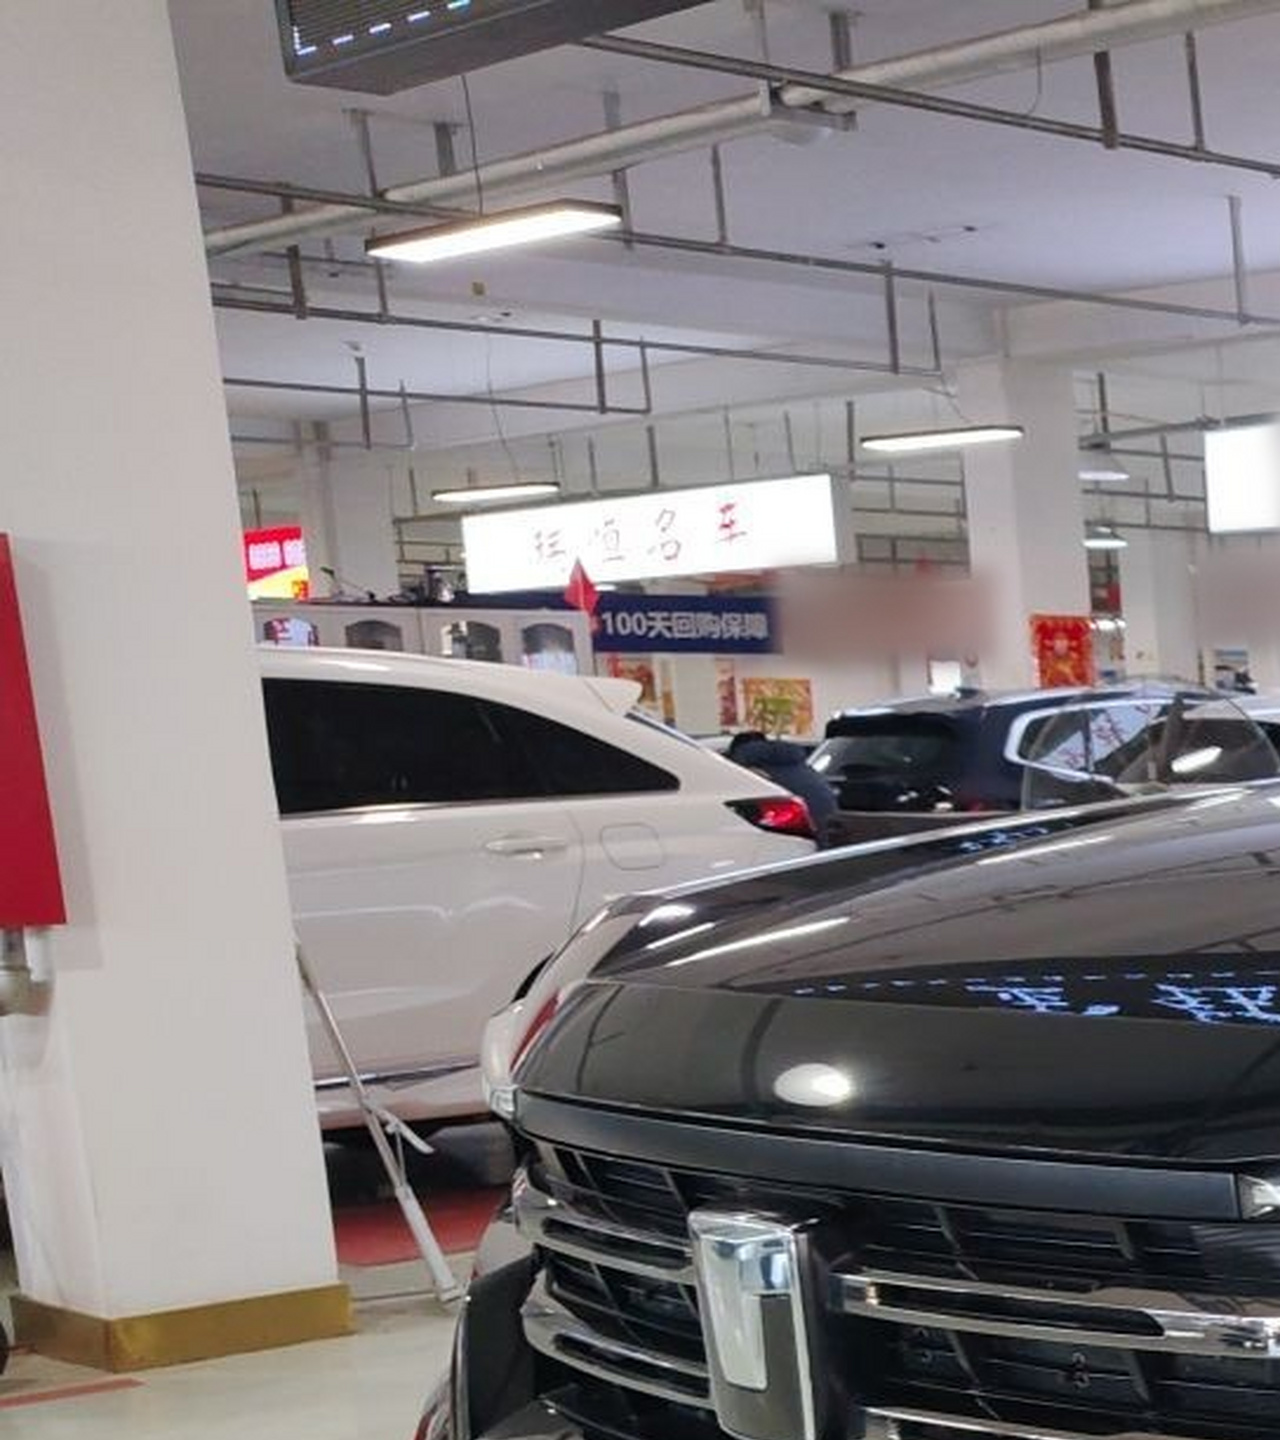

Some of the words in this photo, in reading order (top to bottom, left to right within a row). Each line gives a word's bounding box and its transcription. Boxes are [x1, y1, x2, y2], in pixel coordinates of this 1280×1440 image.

[601, 611, 769, 640] 100天回购保障
